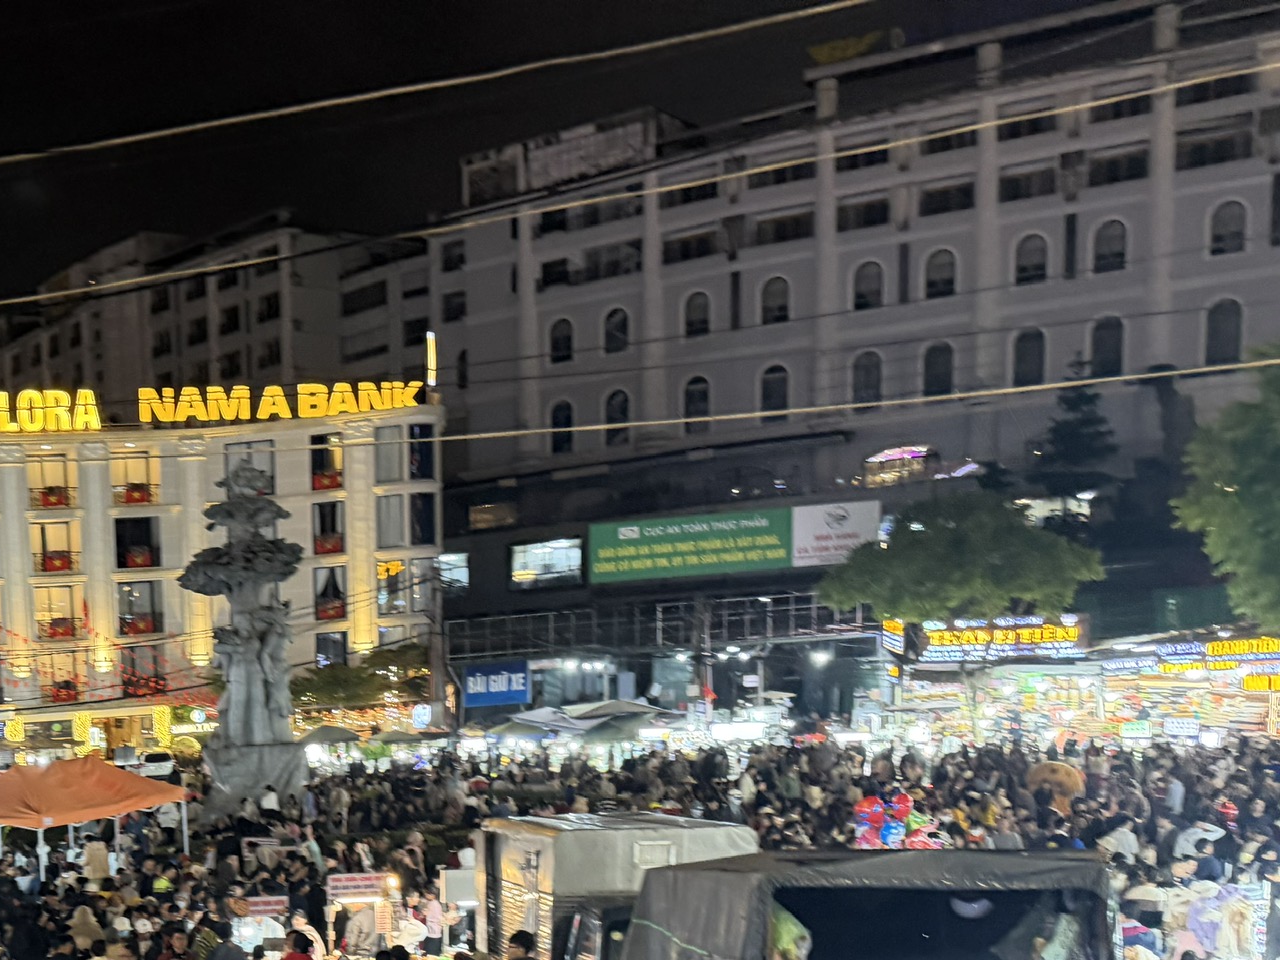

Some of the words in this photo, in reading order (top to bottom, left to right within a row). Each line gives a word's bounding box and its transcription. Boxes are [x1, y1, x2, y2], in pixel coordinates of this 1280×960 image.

[138, 385, 251, 423] NAM
[256, 385, 292, 420] A
[297, 381, 424, 418] BANK
[466, 673, 488, 694] BÃI
[510, 673, 526, 691] XE
